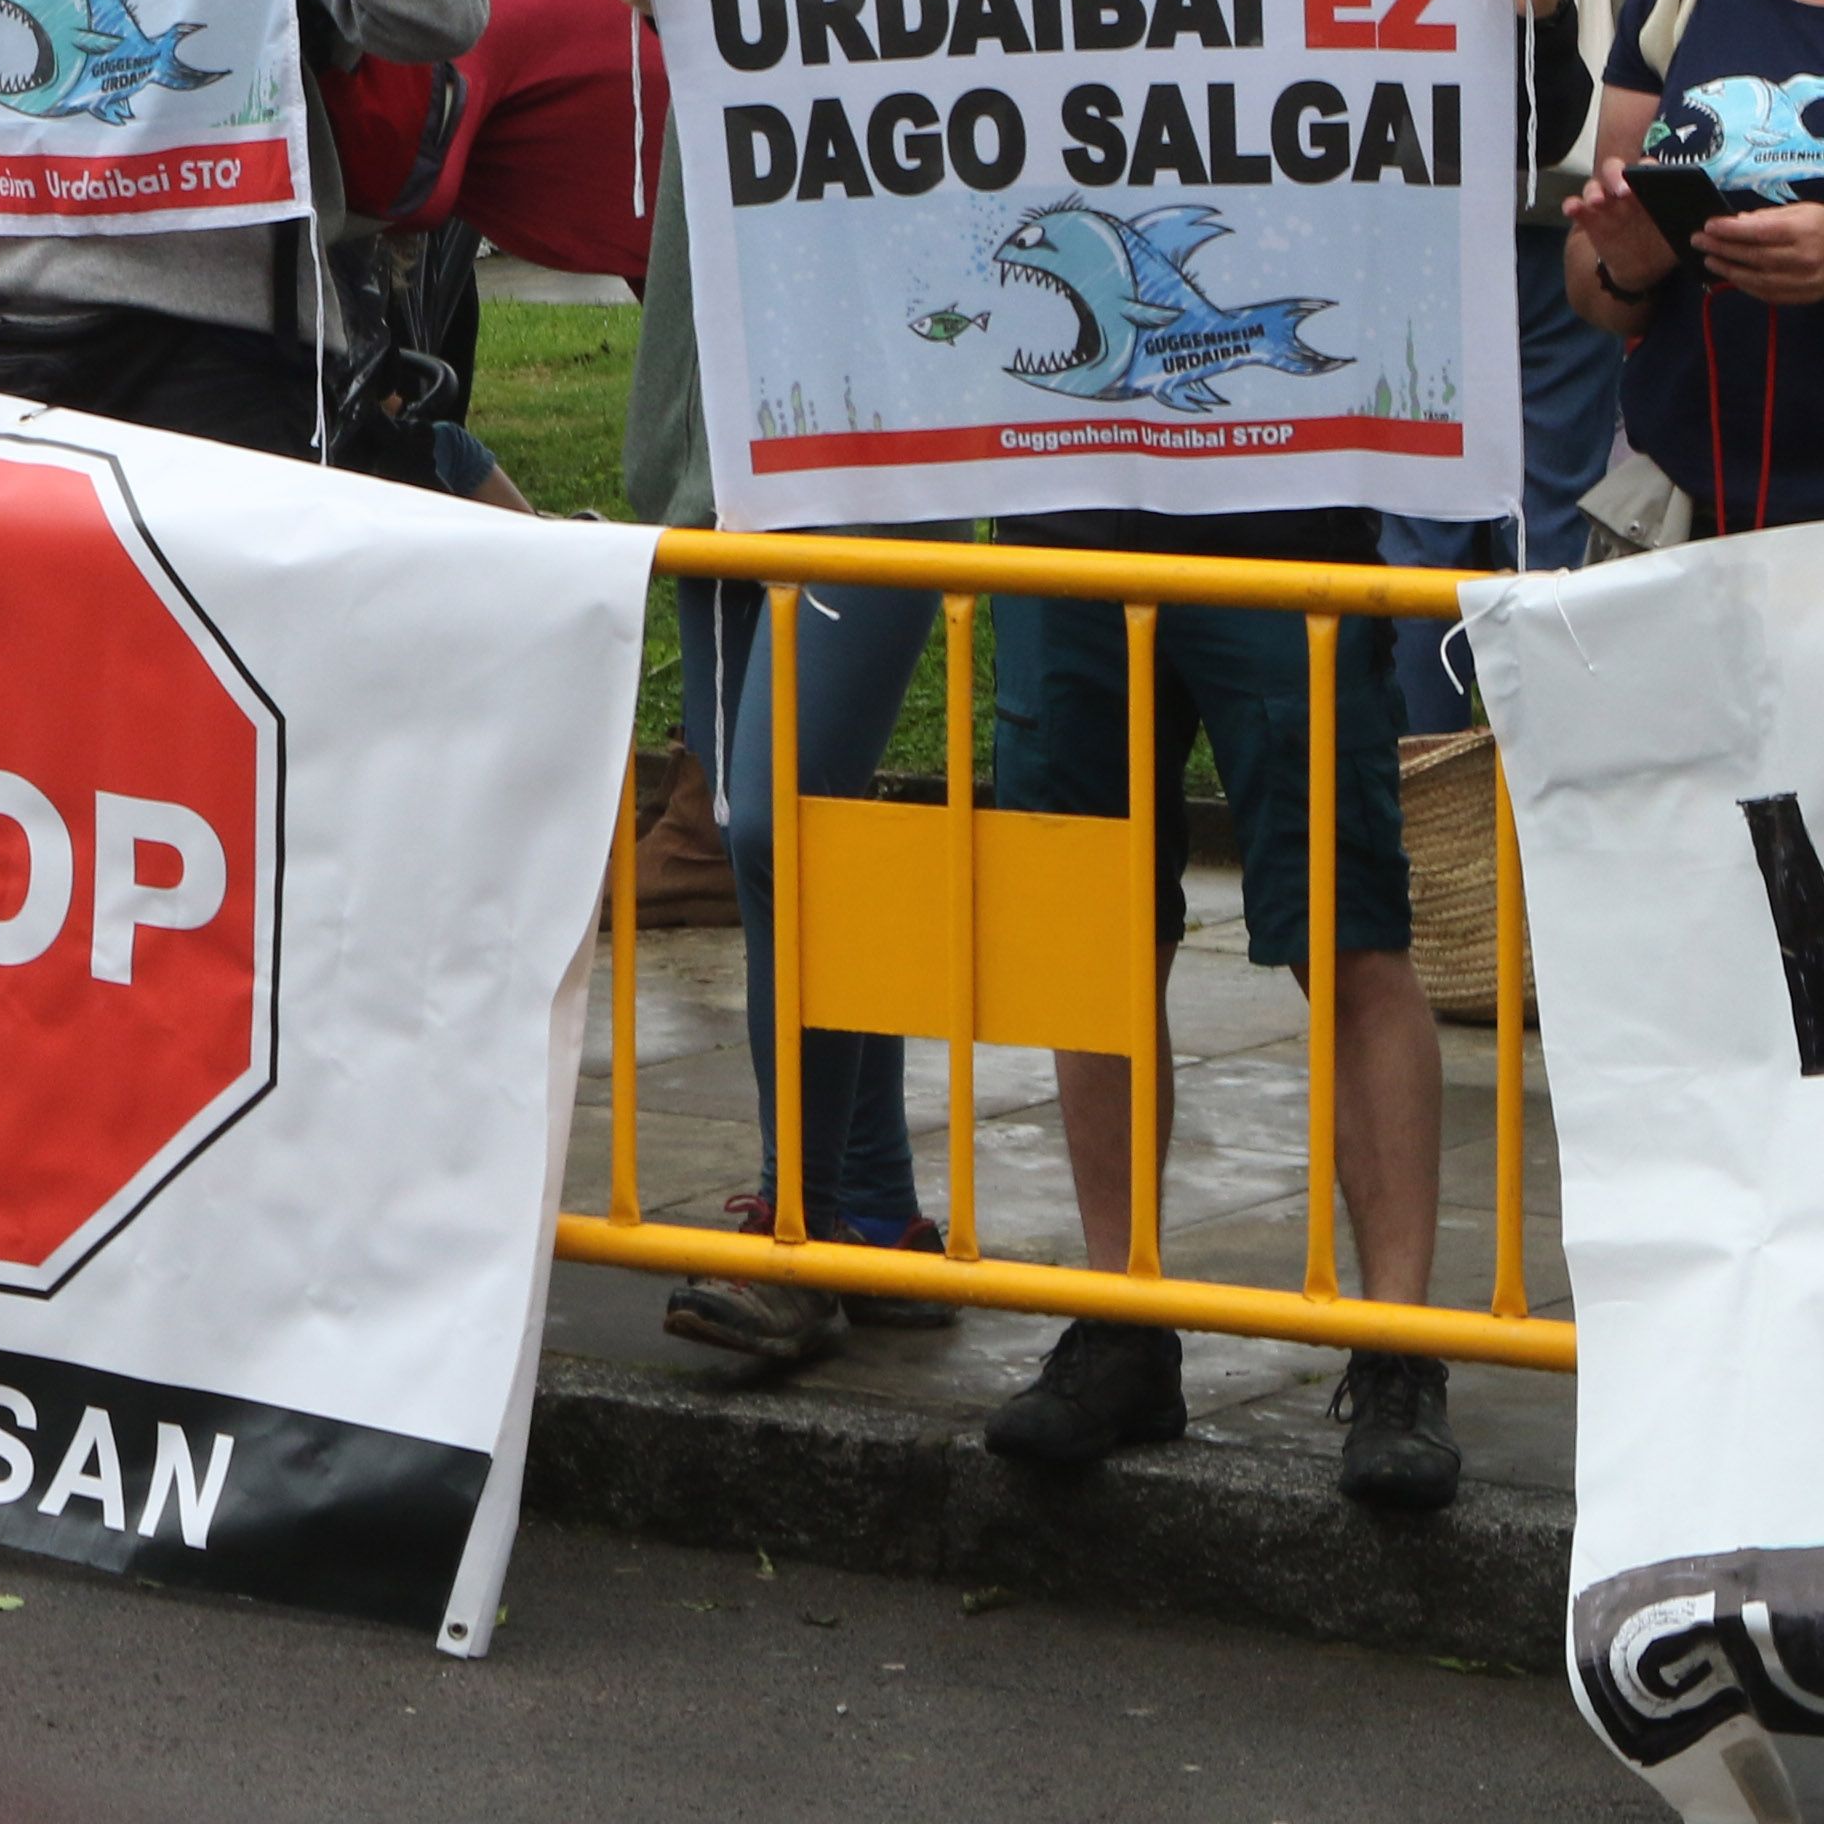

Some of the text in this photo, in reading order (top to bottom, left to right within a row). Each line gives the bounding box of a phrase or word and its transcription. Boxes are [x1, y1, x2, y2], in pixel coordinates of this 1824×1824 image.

[723, 80, 1462, 207] DAGO SALGAI
[44, 162, 171, 202] Urdaibai
[1144, 324, 1266, 356] GUGGENHEIM
[1162, 344, 1252, 375] URDAIBAI
[1000, 425, 1294, 451] Guggenheim Urdaibai STOP
